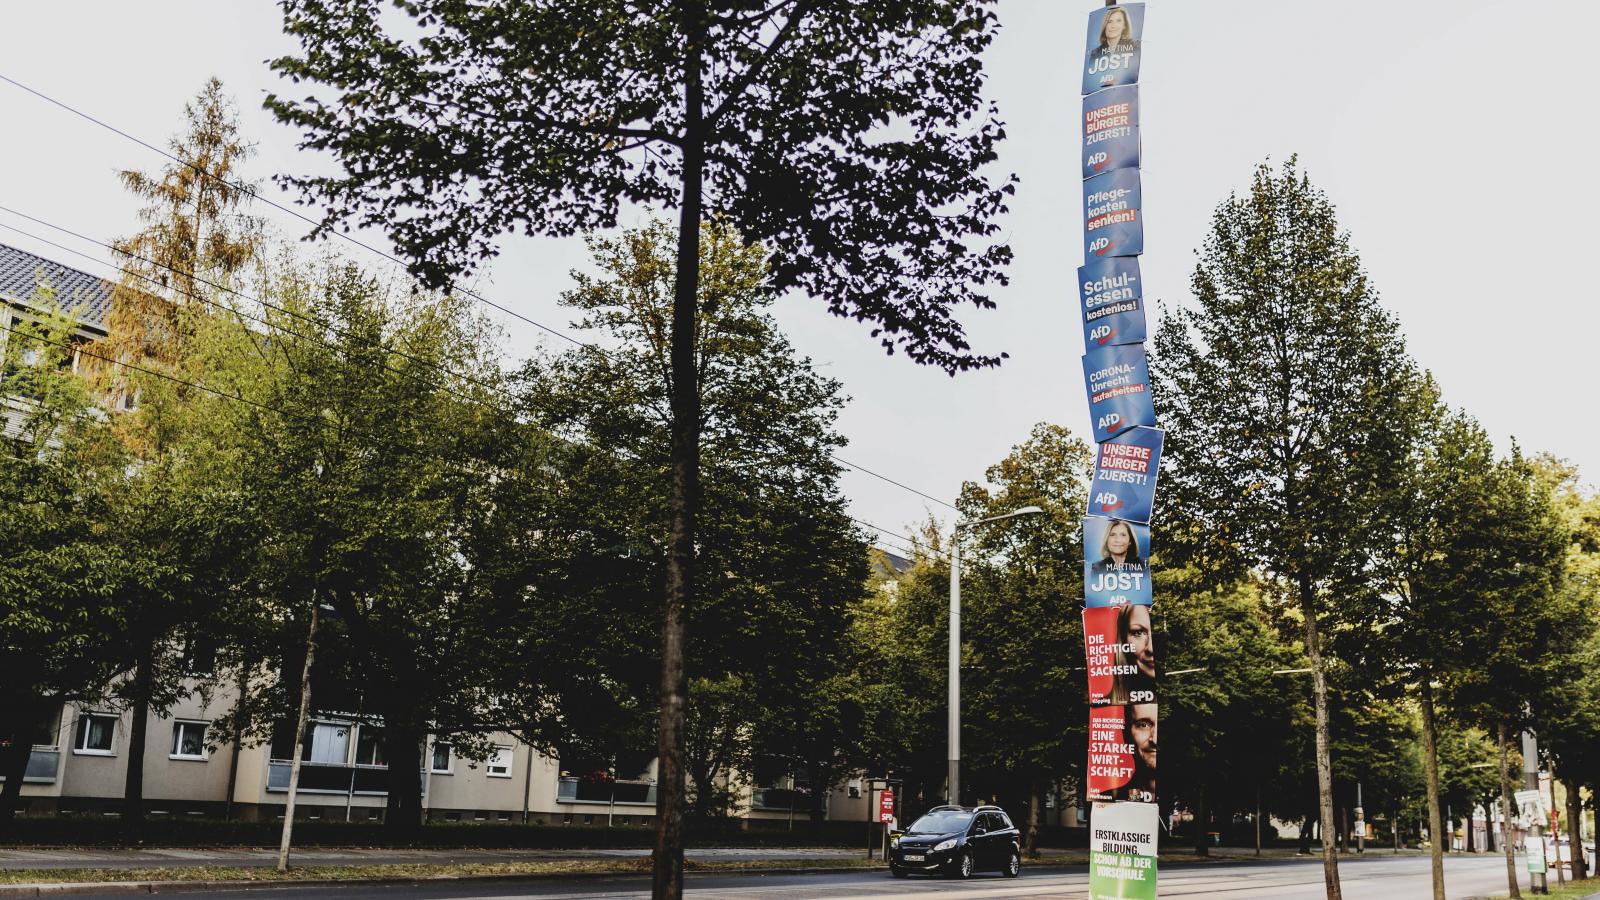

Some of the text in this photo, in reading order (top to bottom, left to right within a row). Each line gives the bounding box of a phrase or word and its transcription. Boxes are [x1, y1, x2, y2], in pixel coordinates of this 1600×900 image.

[1102, 44, 1133, 55] MARTINA
[1088, 53, 1133, 75] JOST
[1087, 103, 1129, 121] UNSERE
[1087, 116, 1128, 134] BÜRGER
[1086, 126, 1131, 145] ZUERST!
[1087, 152, 1107, 166] AfD
[1088, 188, 1131, 207] Pflege-
[1088, 200, 1127, 218] kosten
[1088, 210, 1134, 231] senken!
[1089, 238, 1109, 252] AfD
[1084, 272, 1136, 295] Schul-
[1085, 287, 1133, 307] essen
[1086, 301, 1137, 321] kostenlos!
[1090, 325, 1111, 341] AfD
[1090, 363, 1135, 382] CORONA-
[1091, 375, 1130, 392] Unrecht
[1093, 384, 1144, 403] aufarbeiten!
[1099, 413, 1120, 429] AfD
[1103, 443, 1151, 460] UNSERE
[1101, 455, 1147, 472] BÜRGER
[1098, 469, 1148, 486] ZUERST!
[1094, 492, 1117, 505] AfD
[1106, 563, 1143, 571] MARTINA
[1091, 573, 1143, 592] JOST
[1109, 595, 1126, 604] AfD
[1088, 634, 1104, 644] DIE
[1089, 643, 1136, 655] RICHTIGE
[1090, 654, 1109, 666] FÜR
[1090, 665, 1138, 677] SACHSEN
[1130, 691, 1154, 702] SPD
[1092, 731, 1115, 741] EINE
[1092, 743, 1135, 754] STARKE
[1091, 754, 1124, 765] WIRT-
[1091, 766, 1133, 778] SCHAFT
[881, 813, 893, 821] SPD
[1095, 830, 1151, 844] ERSTKLASSIGE
[1102, 843, 1140, 855] BILDUNG.
[1094, 854, 1151, 868] SCHON AB DER
[1097, 866, 1145, 880] VORSCHULE.
